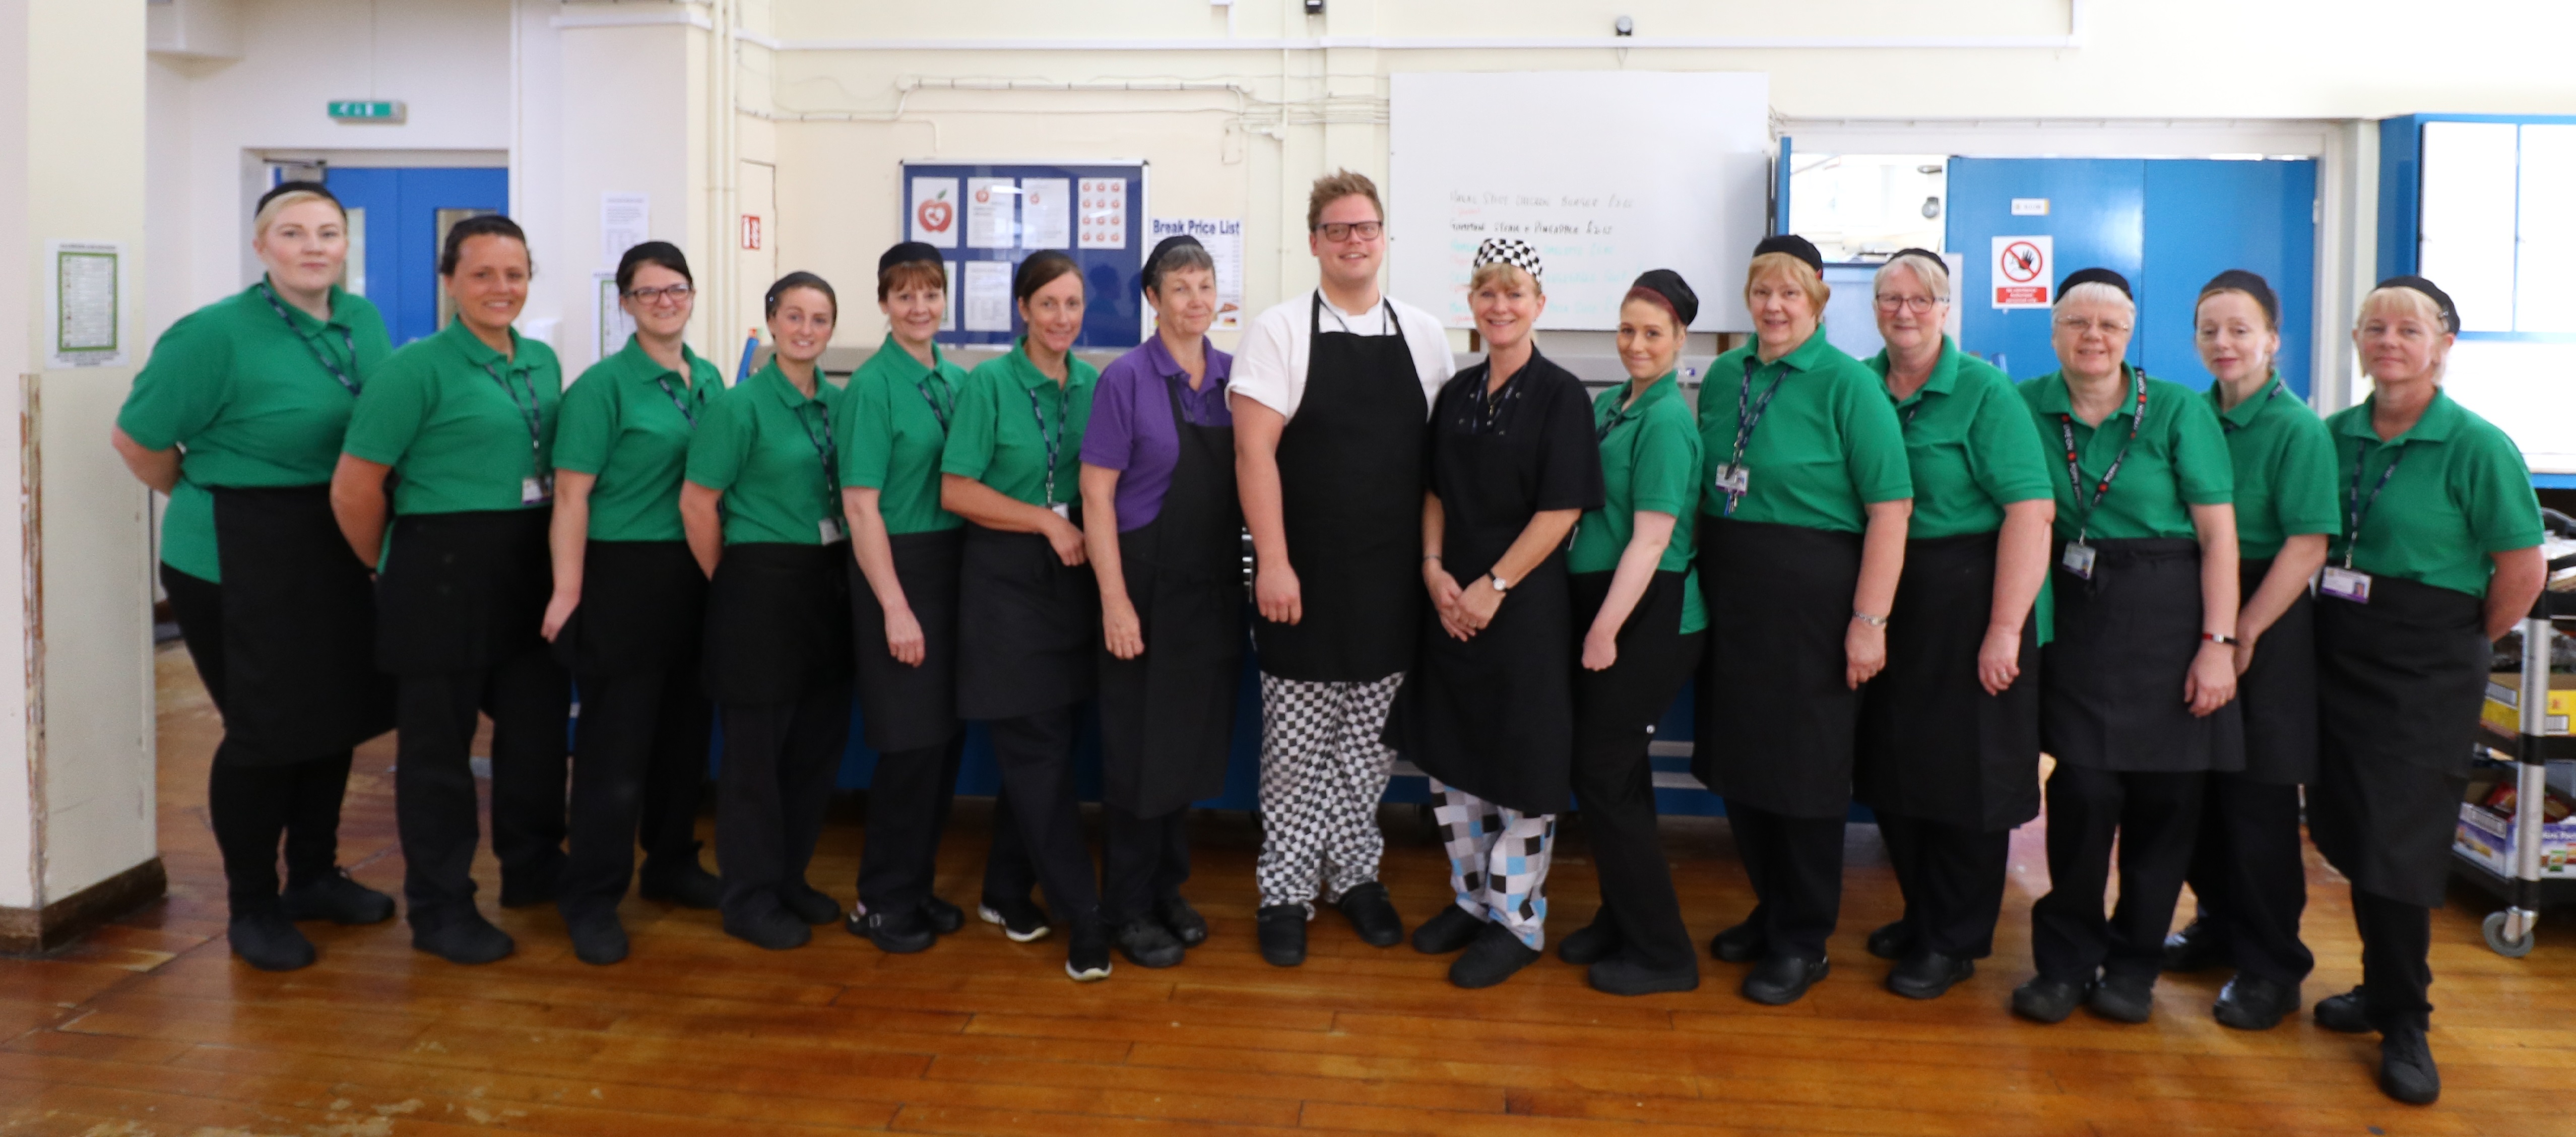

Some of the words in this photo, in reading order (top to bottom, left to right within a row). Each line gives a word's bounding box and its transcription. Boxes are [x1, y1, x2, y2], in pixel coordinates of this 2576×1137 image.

[1153, 220, 1183, 233] Break
[1188, 220, 1215, 233] Price
[1220, 221, 1239, 234] List
[1534, 221, 1578, 234] PINEAPPLE
